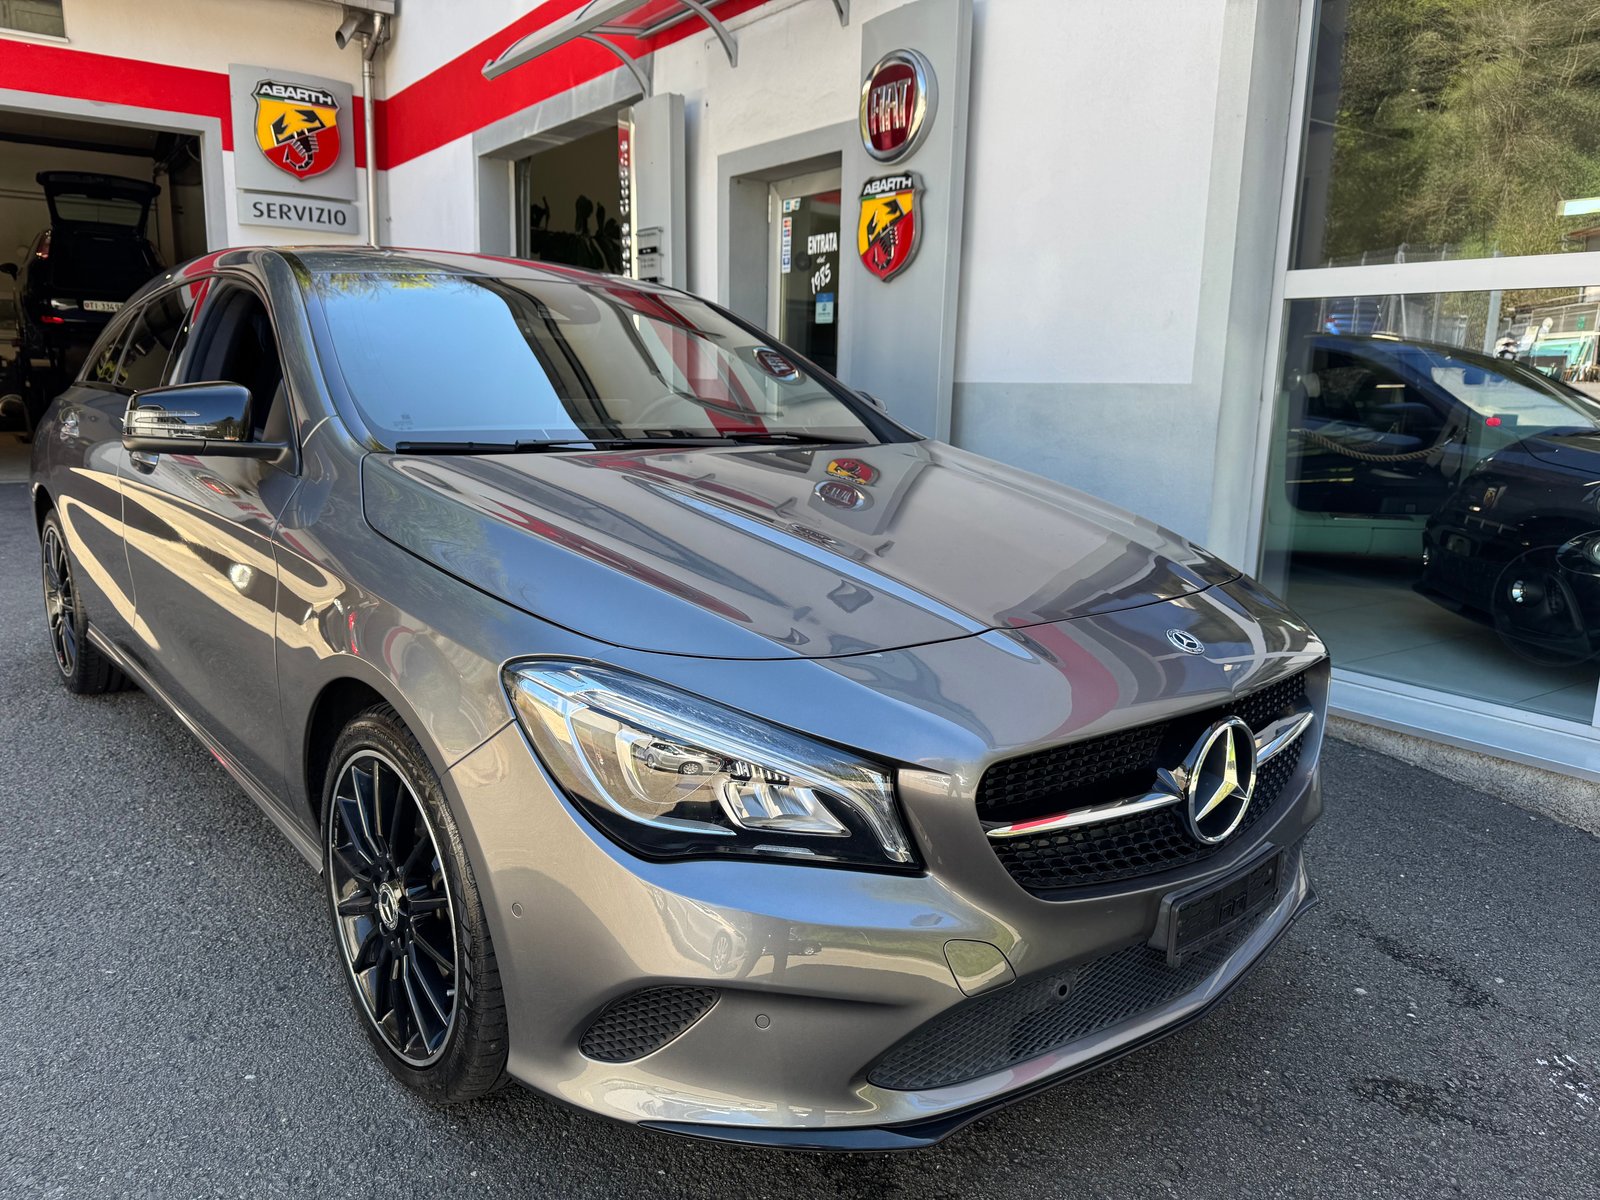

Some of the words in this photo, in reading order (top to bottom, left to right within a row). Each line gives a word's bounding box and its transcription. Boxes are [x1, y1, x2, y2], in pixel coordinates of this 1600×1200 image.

[259, 84, 332, 105] ABARTH
[871, 78, 911, 136] FIAT
[863, 177, 912, 195] ABARTH
[252, 201, 347, 226] SERVIZIO
[807, 232, 838, 255] ENTRATA
[811, 263, 831, 294] 1985
